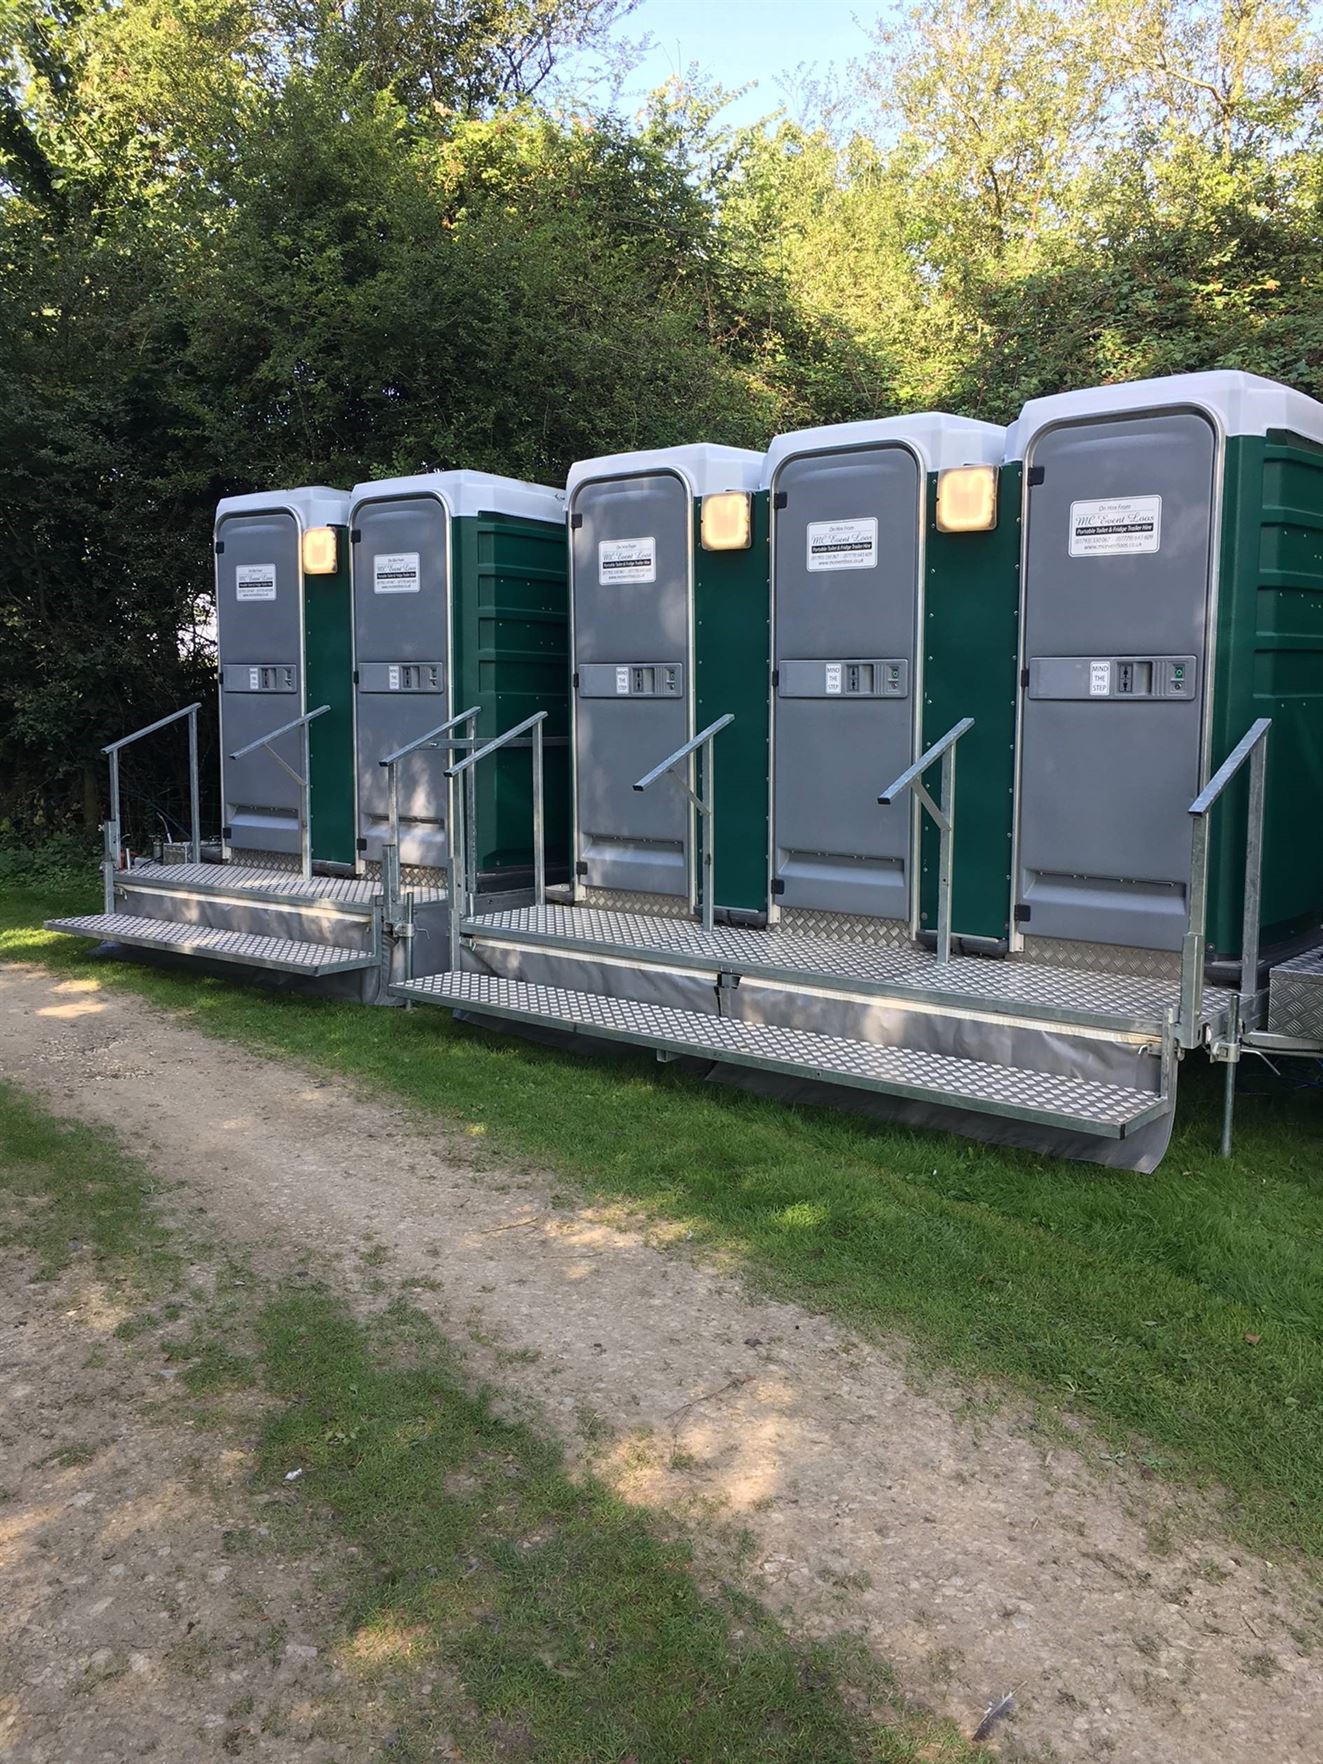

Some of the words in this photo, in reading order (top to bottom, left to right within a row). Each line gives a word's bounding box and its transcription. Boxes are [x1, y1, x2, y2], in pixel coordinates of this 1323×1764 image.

[1076, 514, 1095, 526] MC
[1097, 514, 1125, 525] Event
[1127, 512, 1154, 522] Loos
[828, 534, 850, 543] Event
